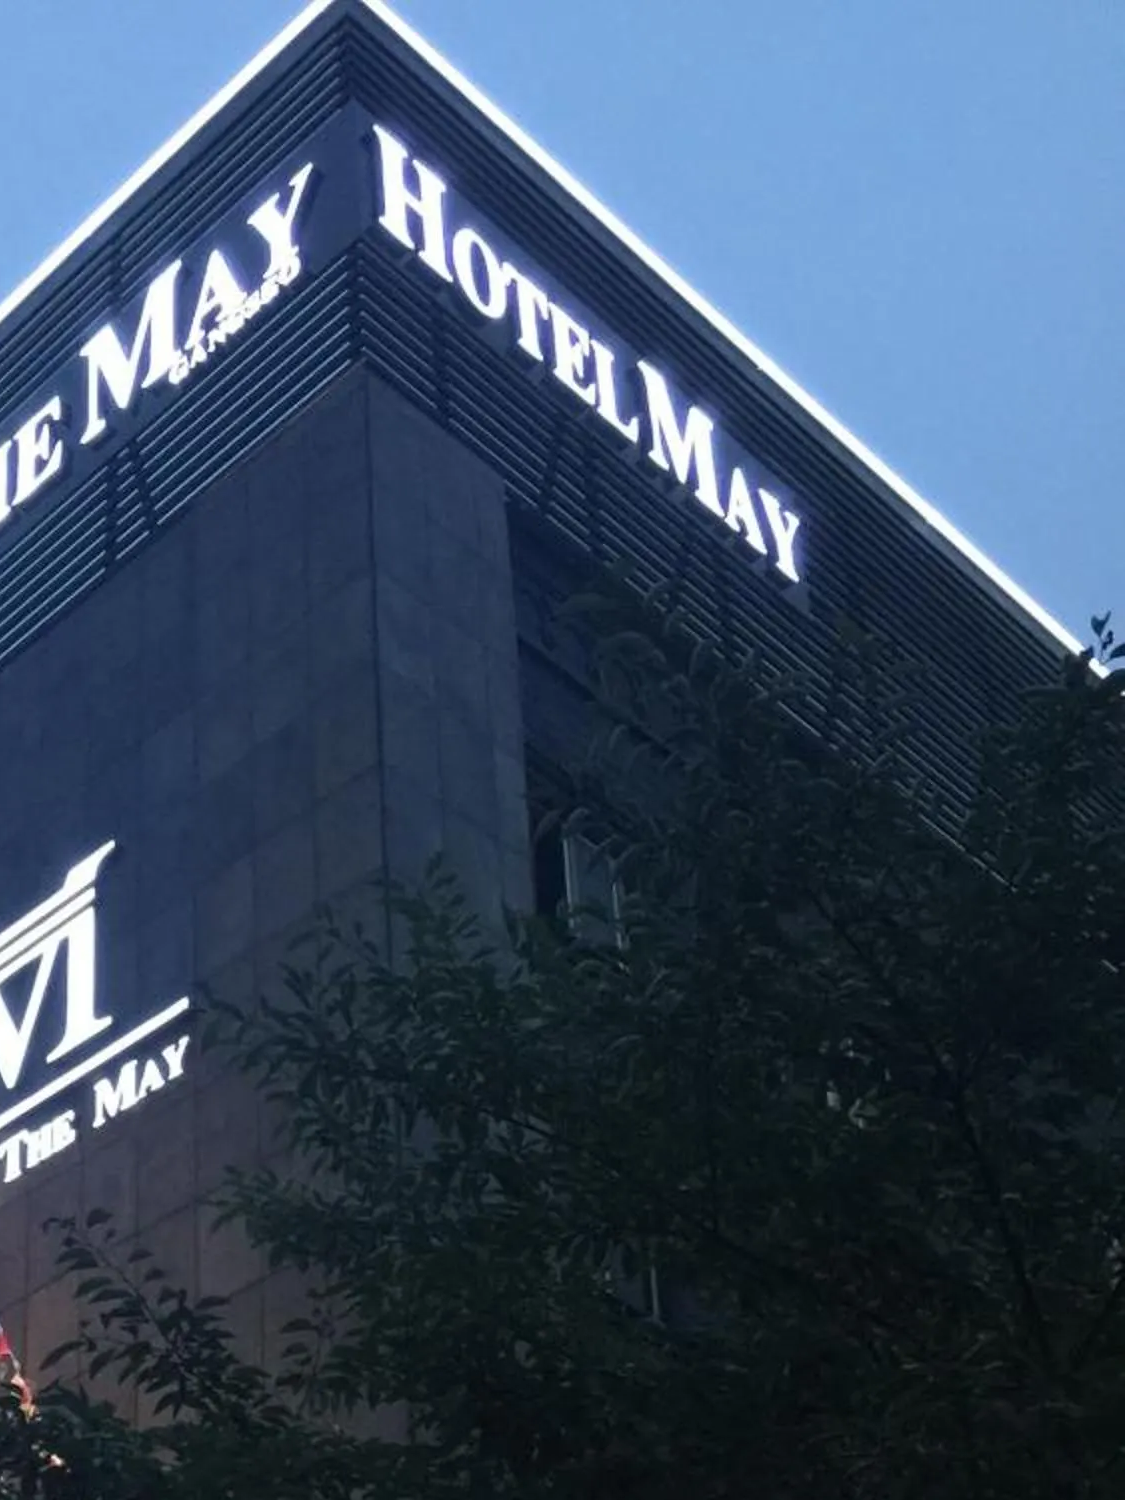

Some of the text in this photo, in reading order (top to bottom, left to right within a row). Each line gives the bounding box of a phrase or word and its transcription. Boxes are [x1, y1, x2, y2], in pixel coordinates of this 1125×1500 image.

[78, 161, 313, 446] MAY
[372, 123, 801, 584] HOTEL MAY
[91, 1035, 190, 1129] MAY
